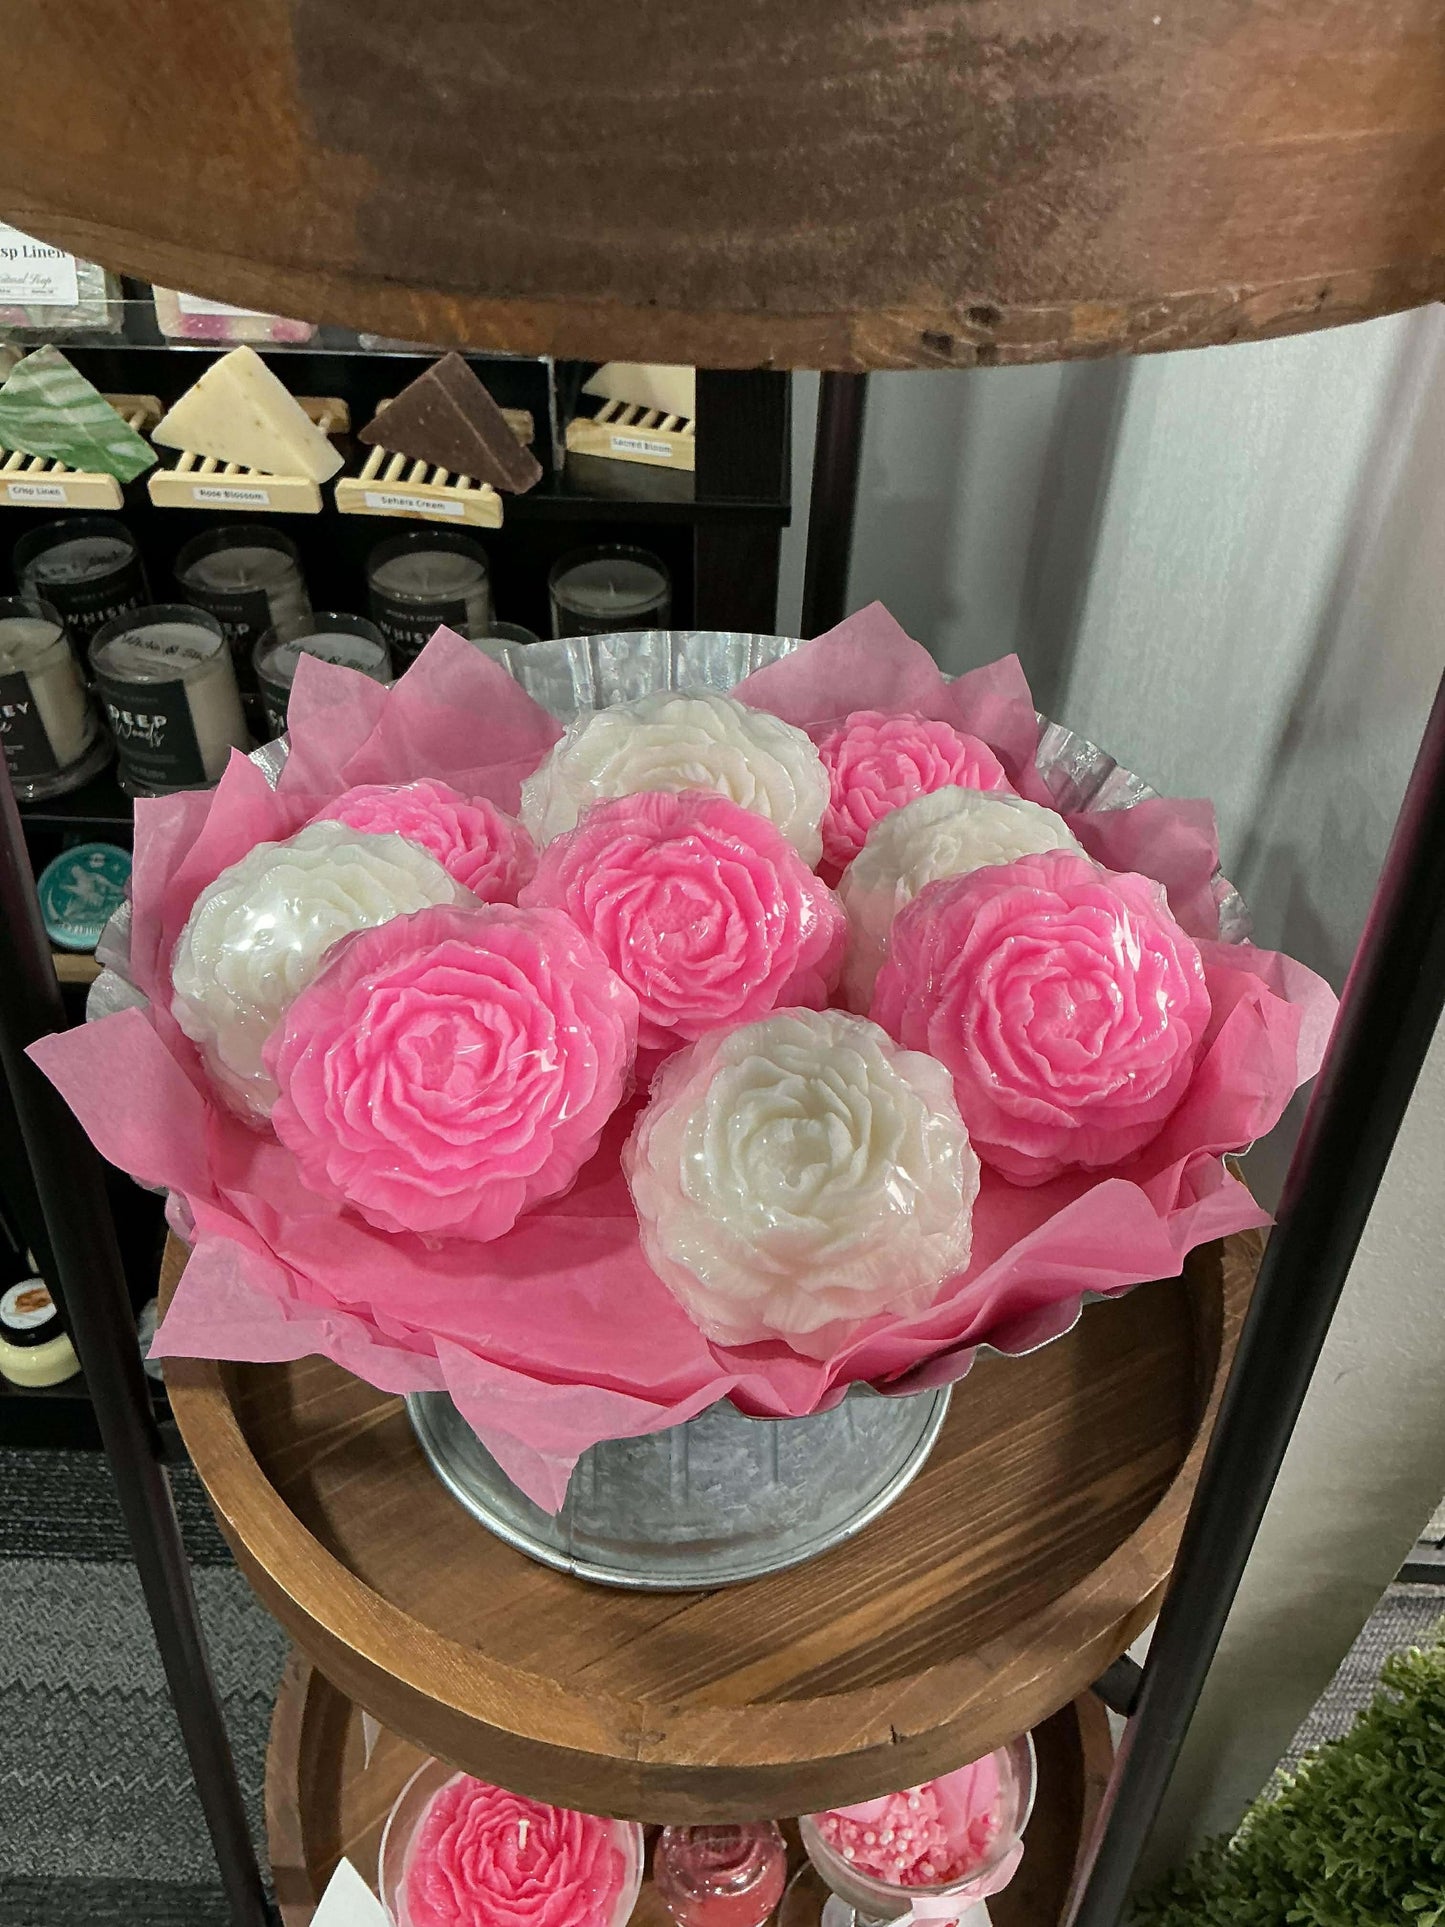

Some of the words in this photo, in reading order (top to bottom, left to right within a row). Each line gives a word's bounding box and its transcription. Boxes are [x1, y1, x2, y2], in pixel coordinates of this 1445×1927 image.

[23, 245, 67, 259] Linen
[12, 486, 34, 495] Crisp
[36, 486, 60, 495] Linen
[200, 489, 221, 497] Rose
[223, 490, 263, 500] Blossom
[381, 496, 415, 506] Sahara
[416, 499, 447, 510] Cream
[380, 619, 429, 644] WHIS
[107, 703, 167, 729] DEEP
